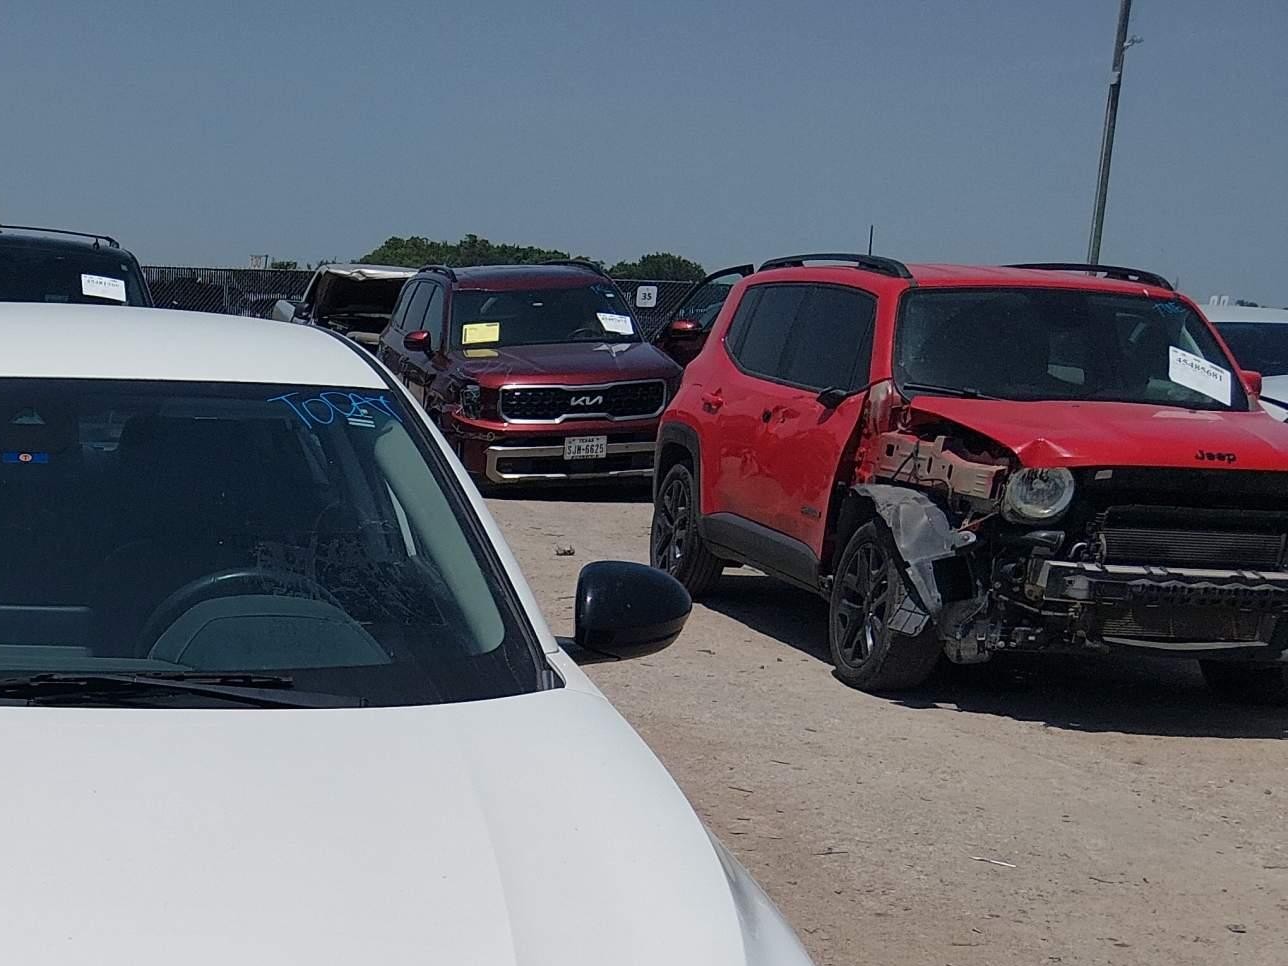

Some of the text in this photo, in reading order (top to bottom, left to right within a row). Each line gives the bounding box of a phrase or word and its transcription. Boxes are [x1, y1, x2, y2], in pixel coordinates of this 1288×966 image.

[641, 292, 653, 301] 35
[570, 395, 604, 406] KIA
[266, 391, 403, 430] TODAY
[1194, 449, 1237, 465] Jeep
